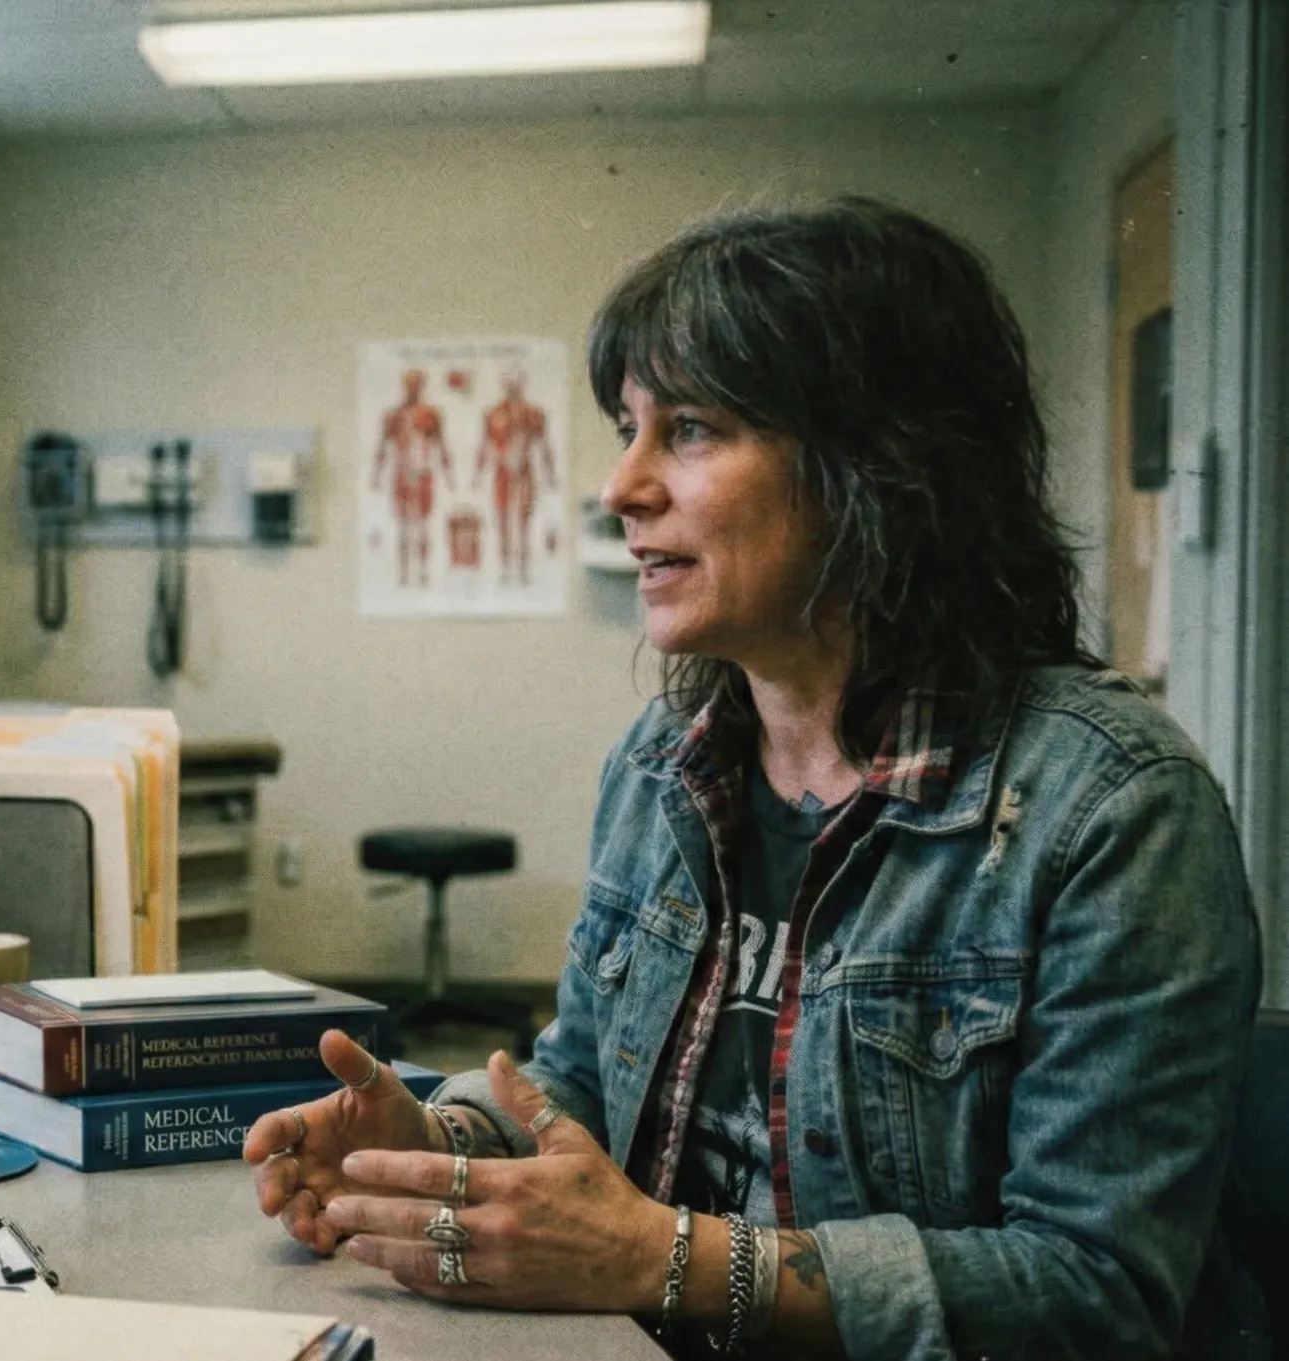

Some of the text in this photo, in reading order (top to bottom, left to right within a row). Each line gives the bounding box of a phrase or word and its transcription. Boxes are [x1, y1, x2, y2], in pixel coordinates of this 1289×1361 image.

[142, 1032, 278, 1053] MEDICAL REFERENCE
[144, 1104, 235, 1129] MEDICAL
